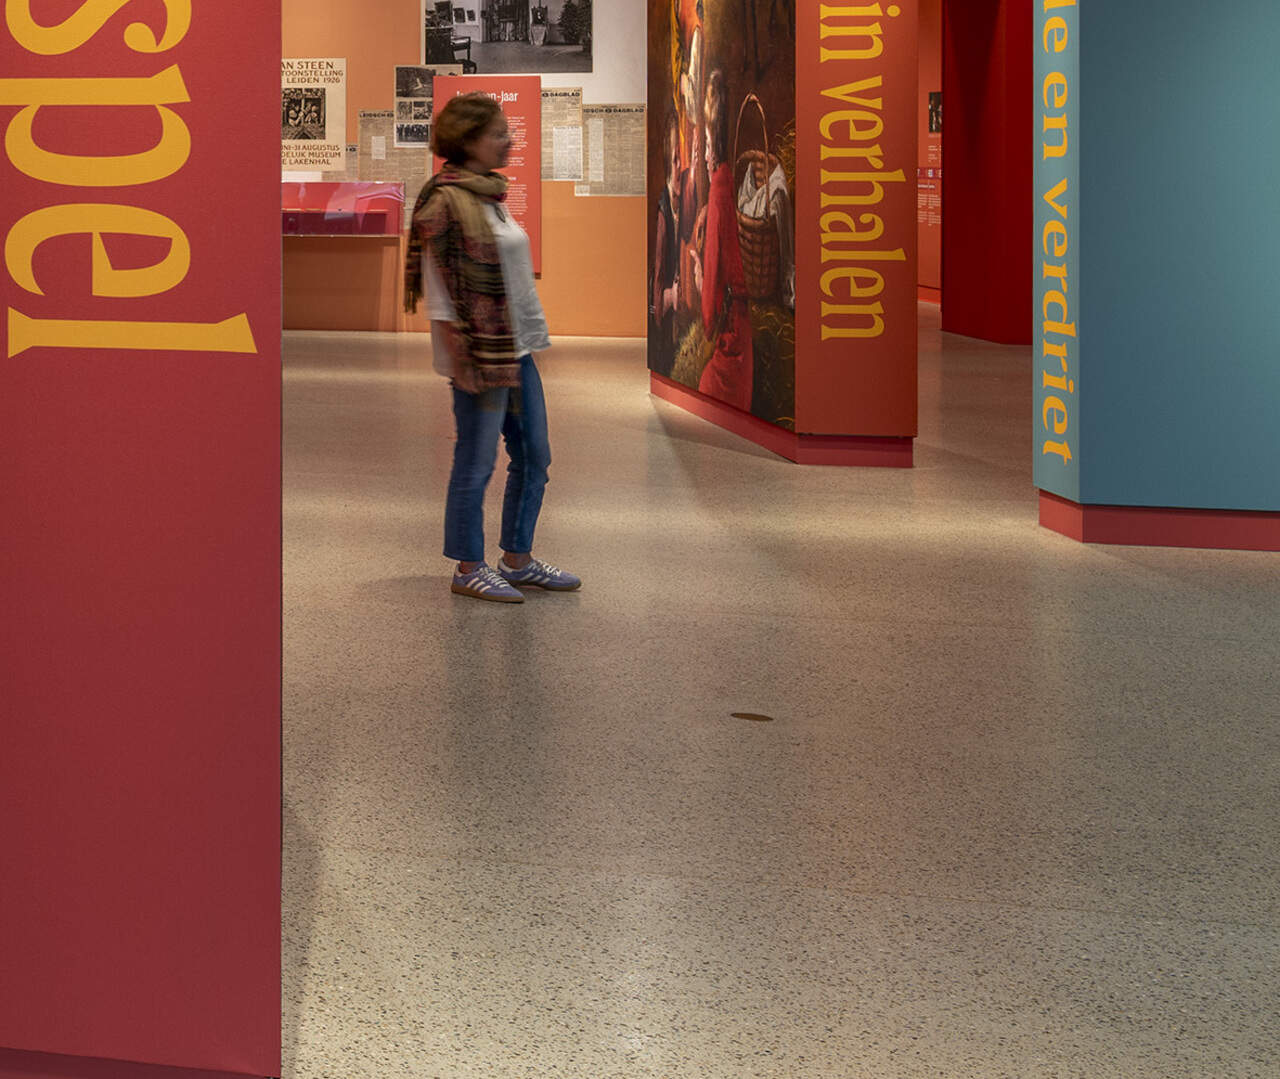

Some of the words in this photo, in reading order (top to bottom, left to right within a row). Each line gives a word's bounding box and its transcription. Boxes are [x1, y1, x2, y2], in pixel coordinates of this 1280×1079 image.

[297, 61, 334, 70] STEEN
[819, 3, 901, 63] in
[1042, 70, 1068, 159] en
[819, 75, 907, 341] verhalen
[1042, 177, 1076, 465] verdriet
